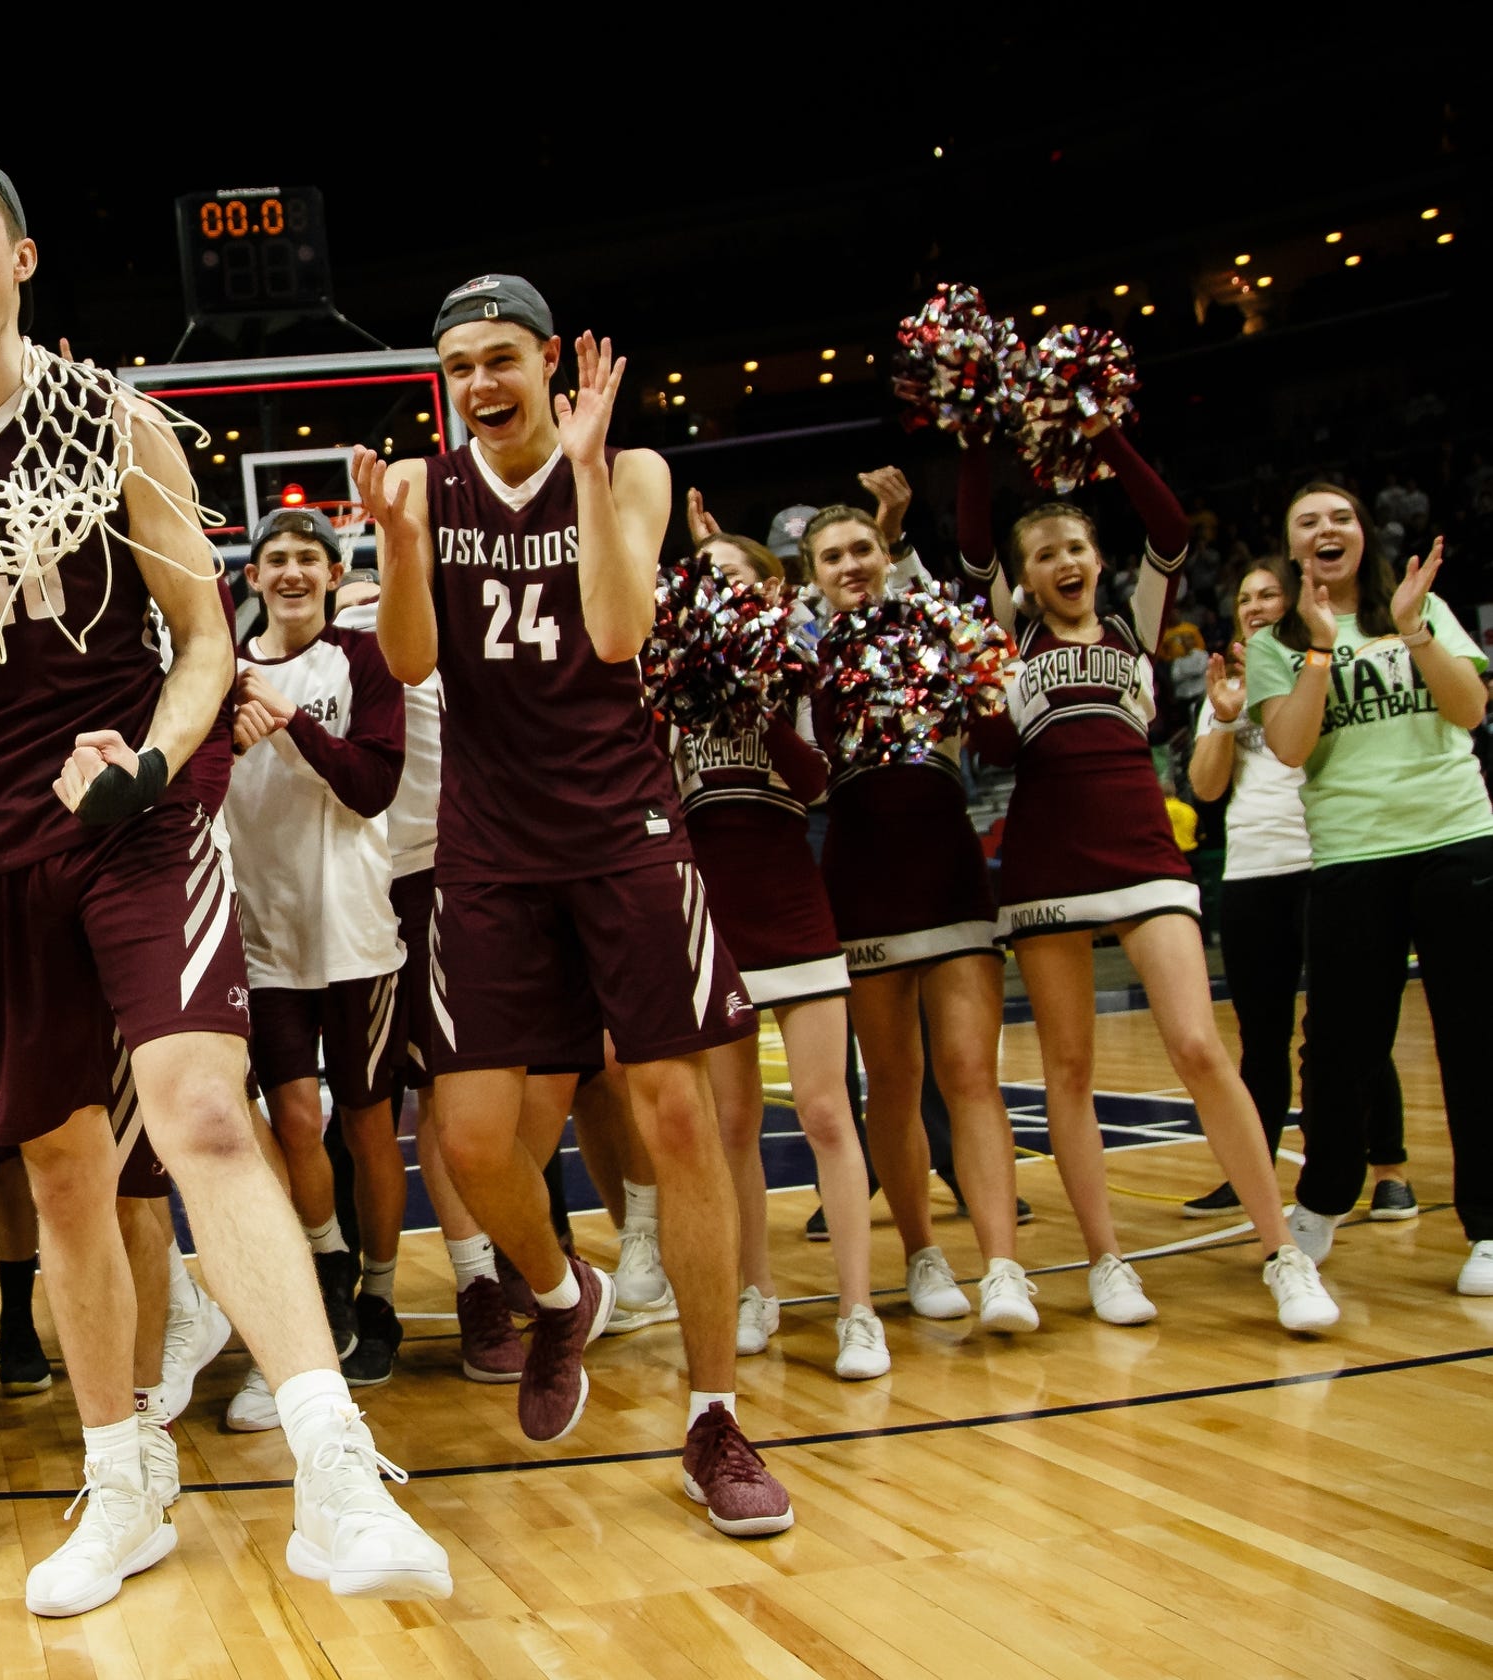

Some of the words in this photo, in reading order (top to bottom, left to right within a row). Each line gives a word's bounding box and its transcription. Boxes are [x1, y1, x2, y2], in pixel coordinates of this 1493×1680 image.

[200, 199, 284, 239] 00.0
[483, 579, 561, 662] 24
[1019, 644, 1142, 706] OSKALOOSA
[1011, 904, 1067, 930] INDIANS
